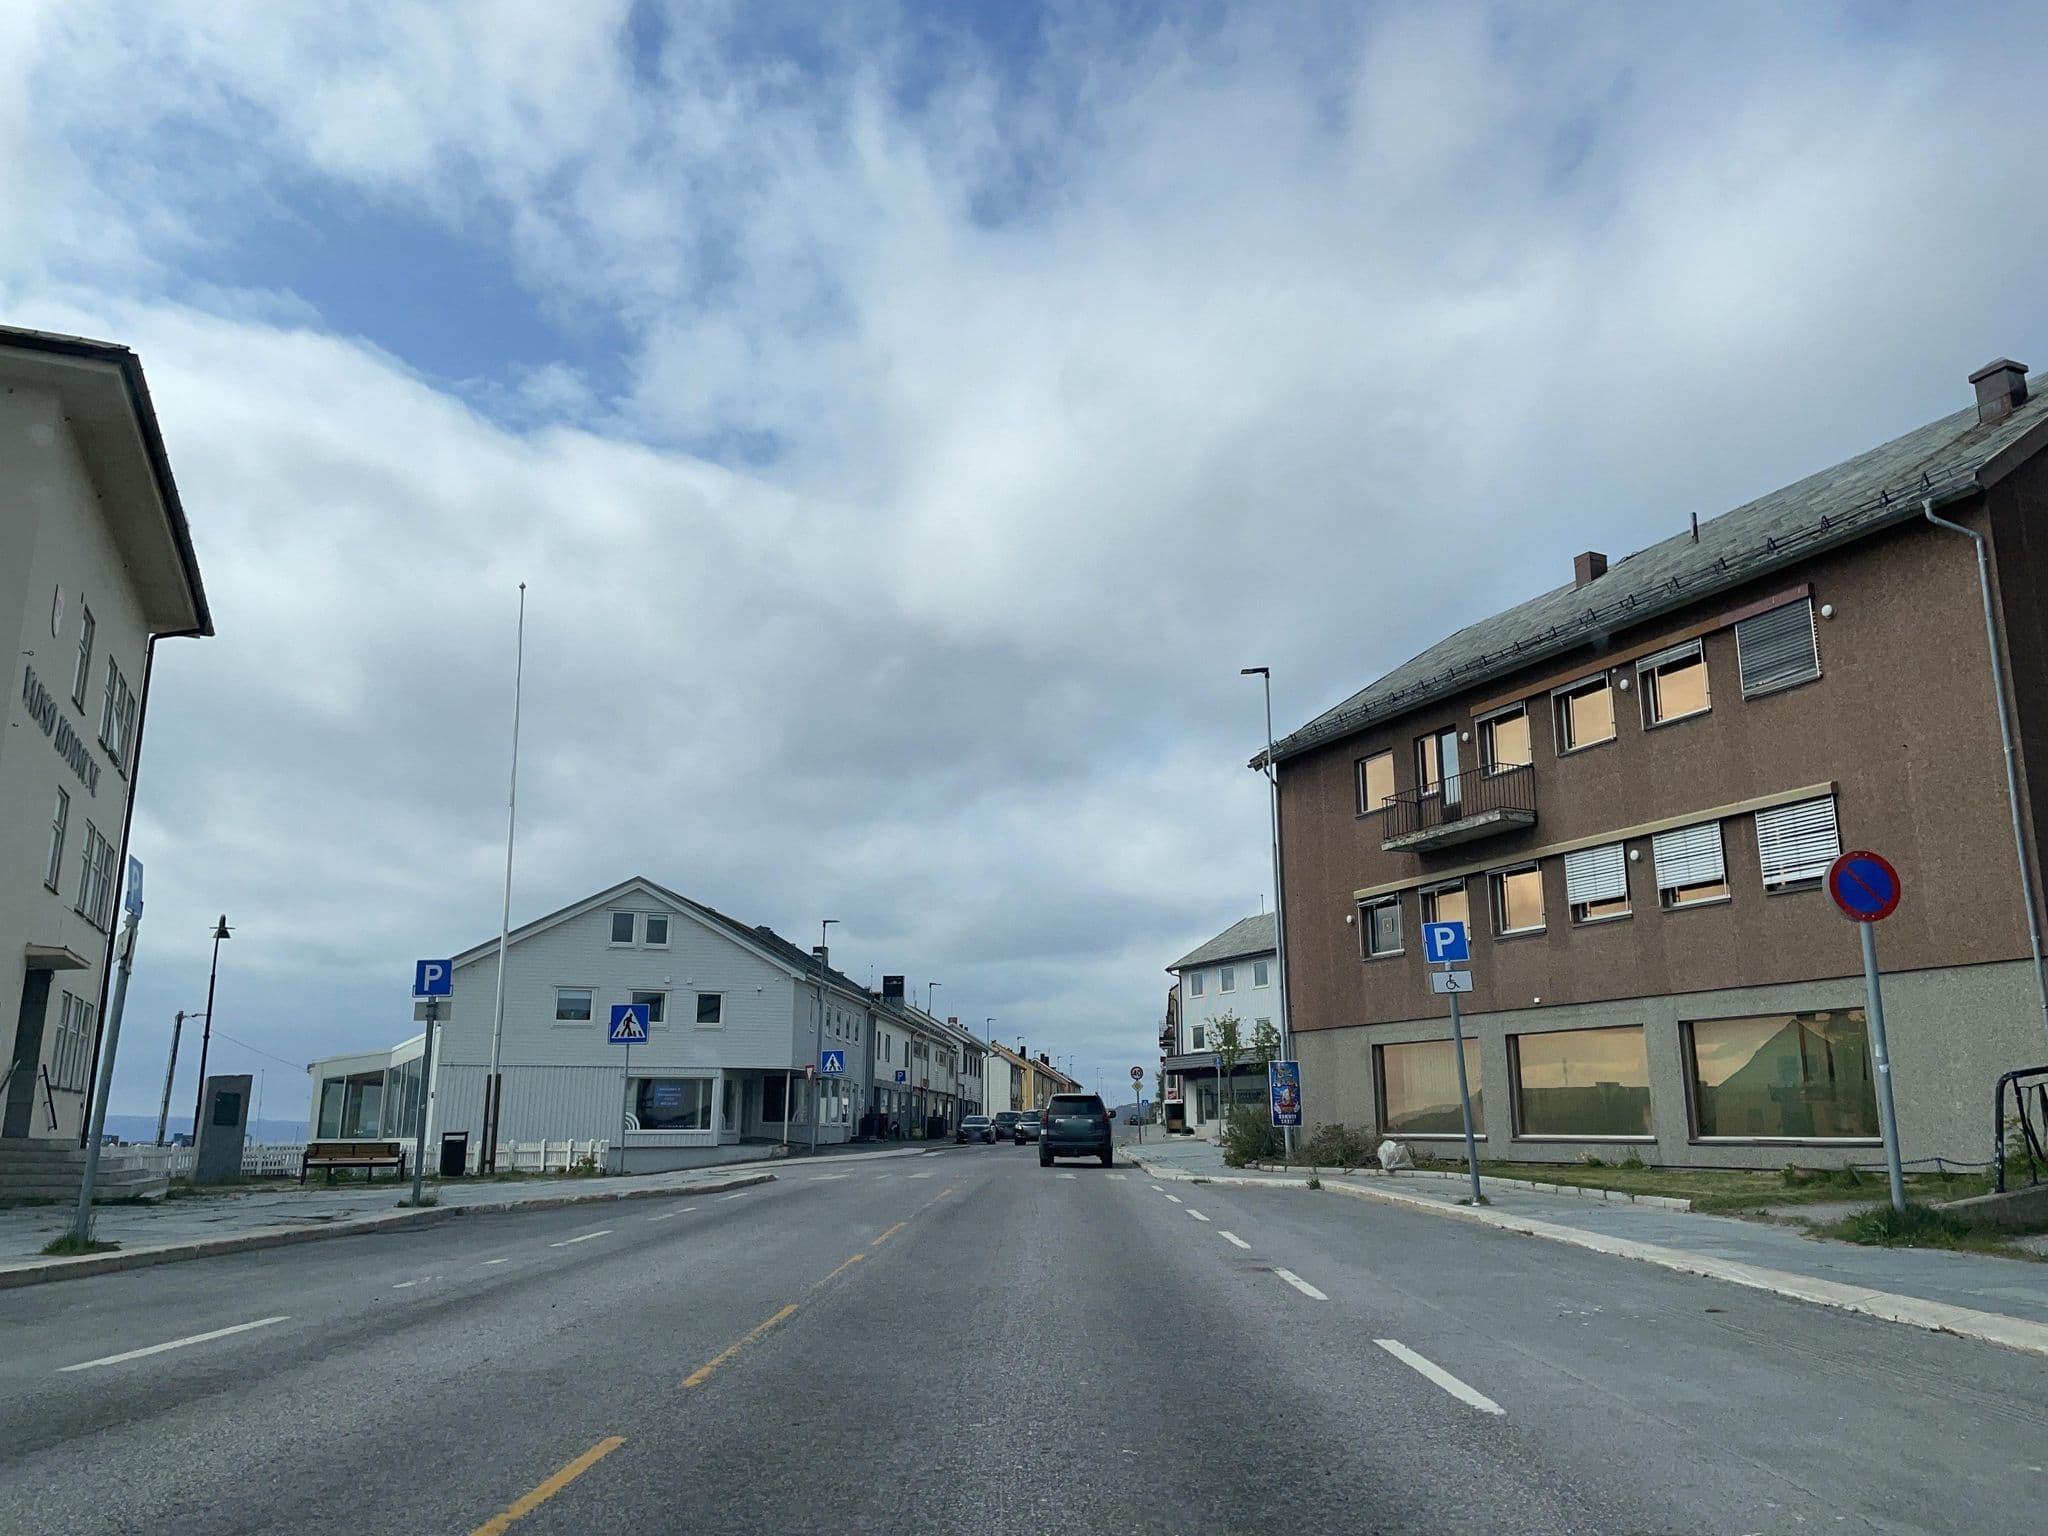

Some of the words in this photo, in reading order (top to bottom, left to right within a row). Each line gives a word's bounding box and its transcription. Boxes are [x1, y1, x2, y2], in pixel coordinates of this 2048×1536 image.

[1434, 927, 1456, 957] P
[424, 964, 443, 991] P
[897, 1071, 904, 1080] P
